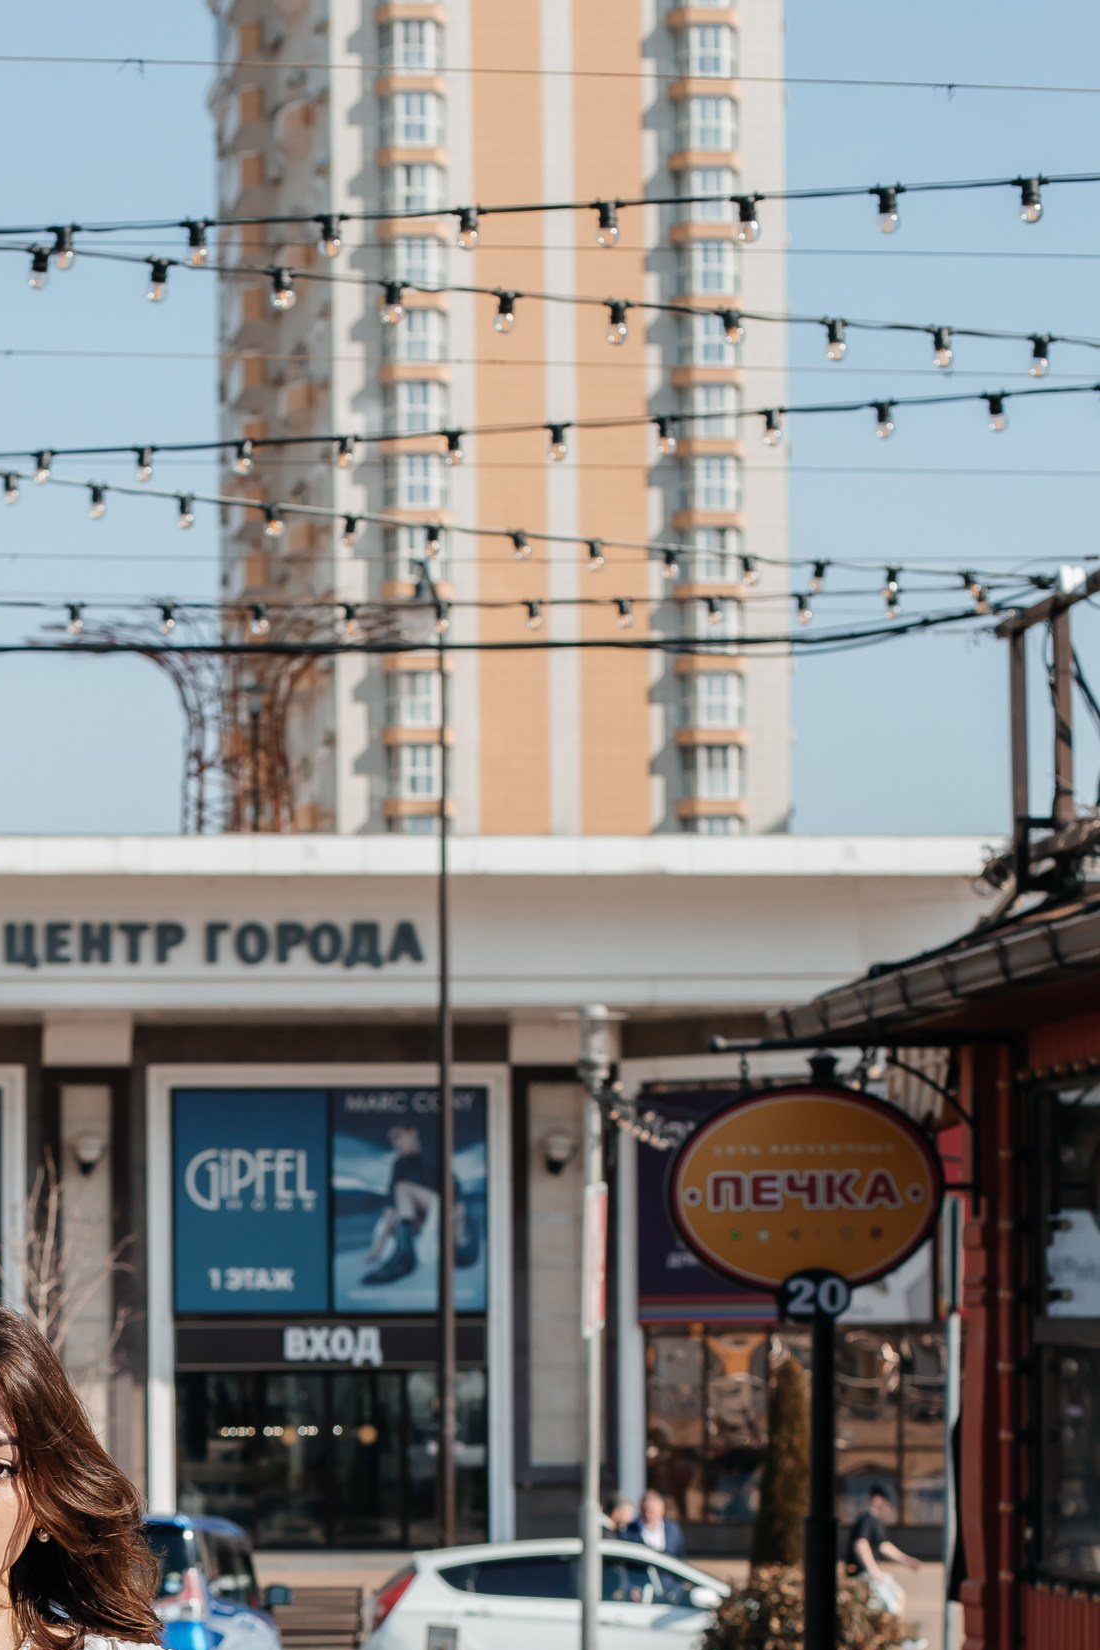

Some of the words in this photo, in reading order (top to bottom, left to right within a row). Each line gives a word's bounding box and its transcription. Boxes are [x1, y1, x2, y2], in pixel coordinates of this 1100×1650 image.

[2, 921, 186, 969] ЦЕНТР
[204, 921, 426, 969] ГОРОДА
[707, 1169, 903, 1212] ПЕЧКА
[207, 1266, 222, 1292] 1
[224, 1266, 296, 1292] ЭТАЖ
[786, 1277, 849, 1315] 20
[283, 1326, 383, 1368] ВХОД
